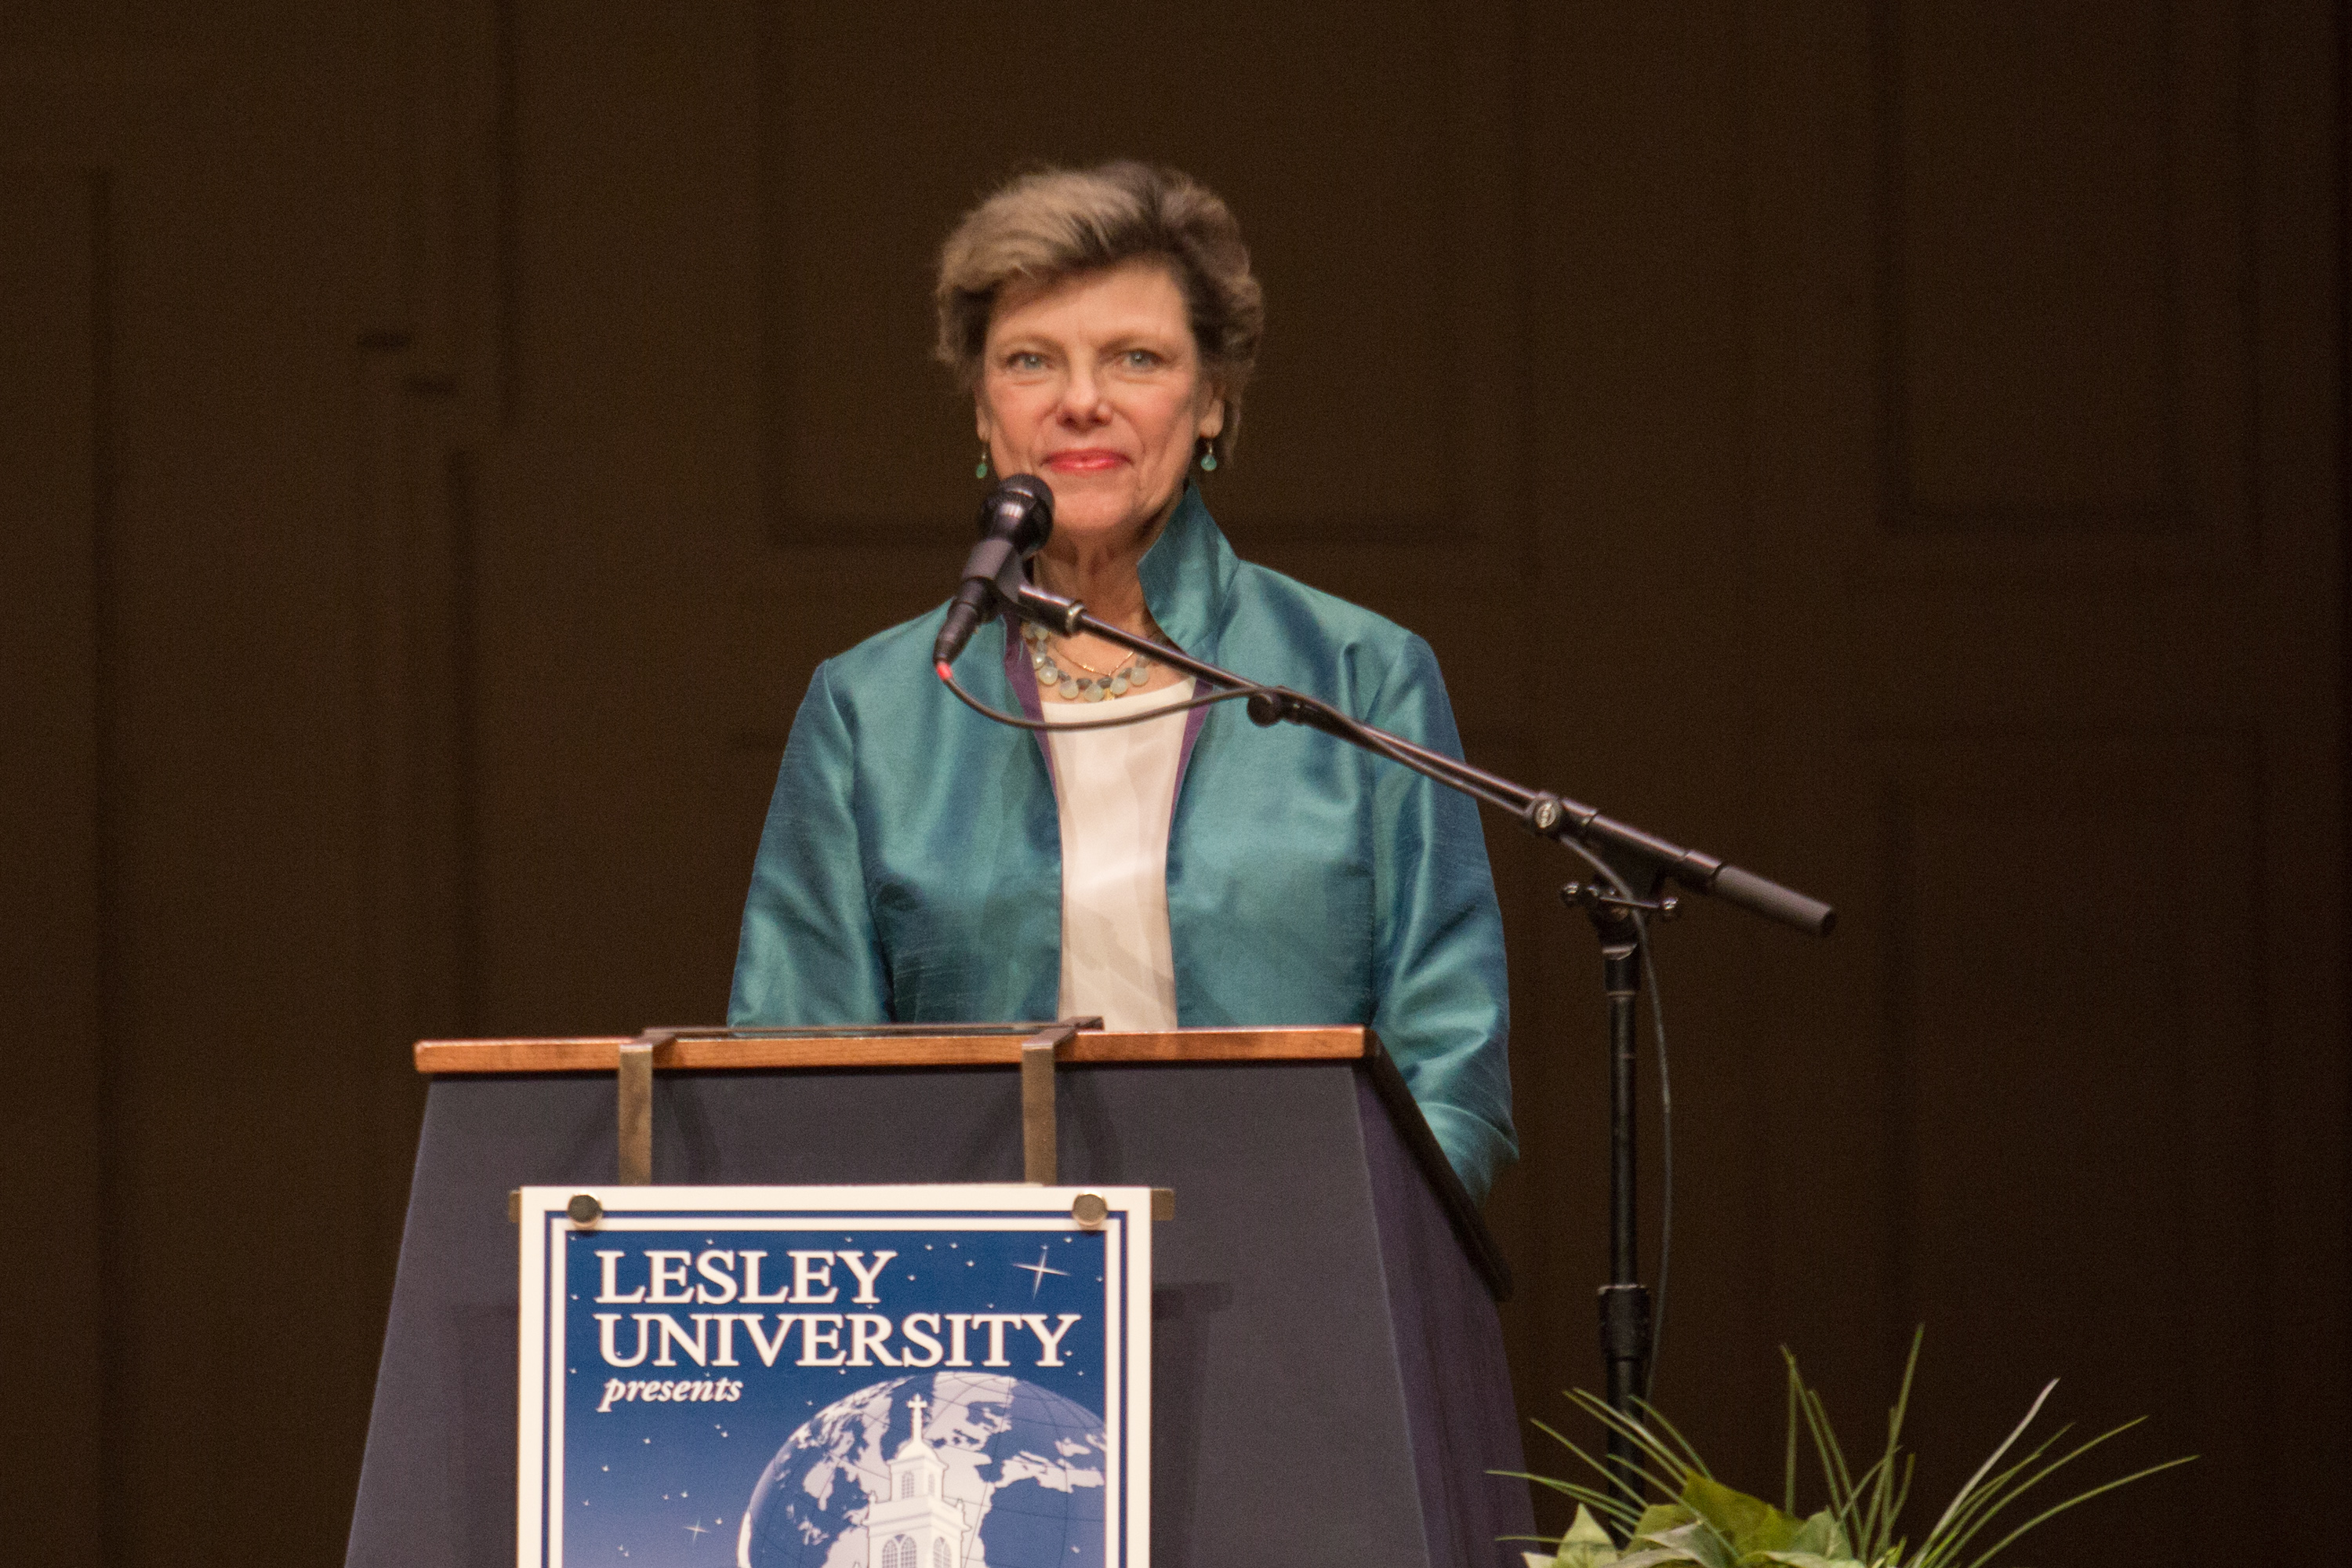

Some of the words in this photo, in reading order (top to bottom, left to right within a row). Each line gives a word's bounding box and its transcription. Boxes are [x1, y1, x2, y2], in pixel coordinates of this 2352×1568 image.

[593, 1249, 898, 1305] LESLEY
[592, 1312, 1082, 1367] UNIVERSITY
[596, 1377, 743, 1412] presents
